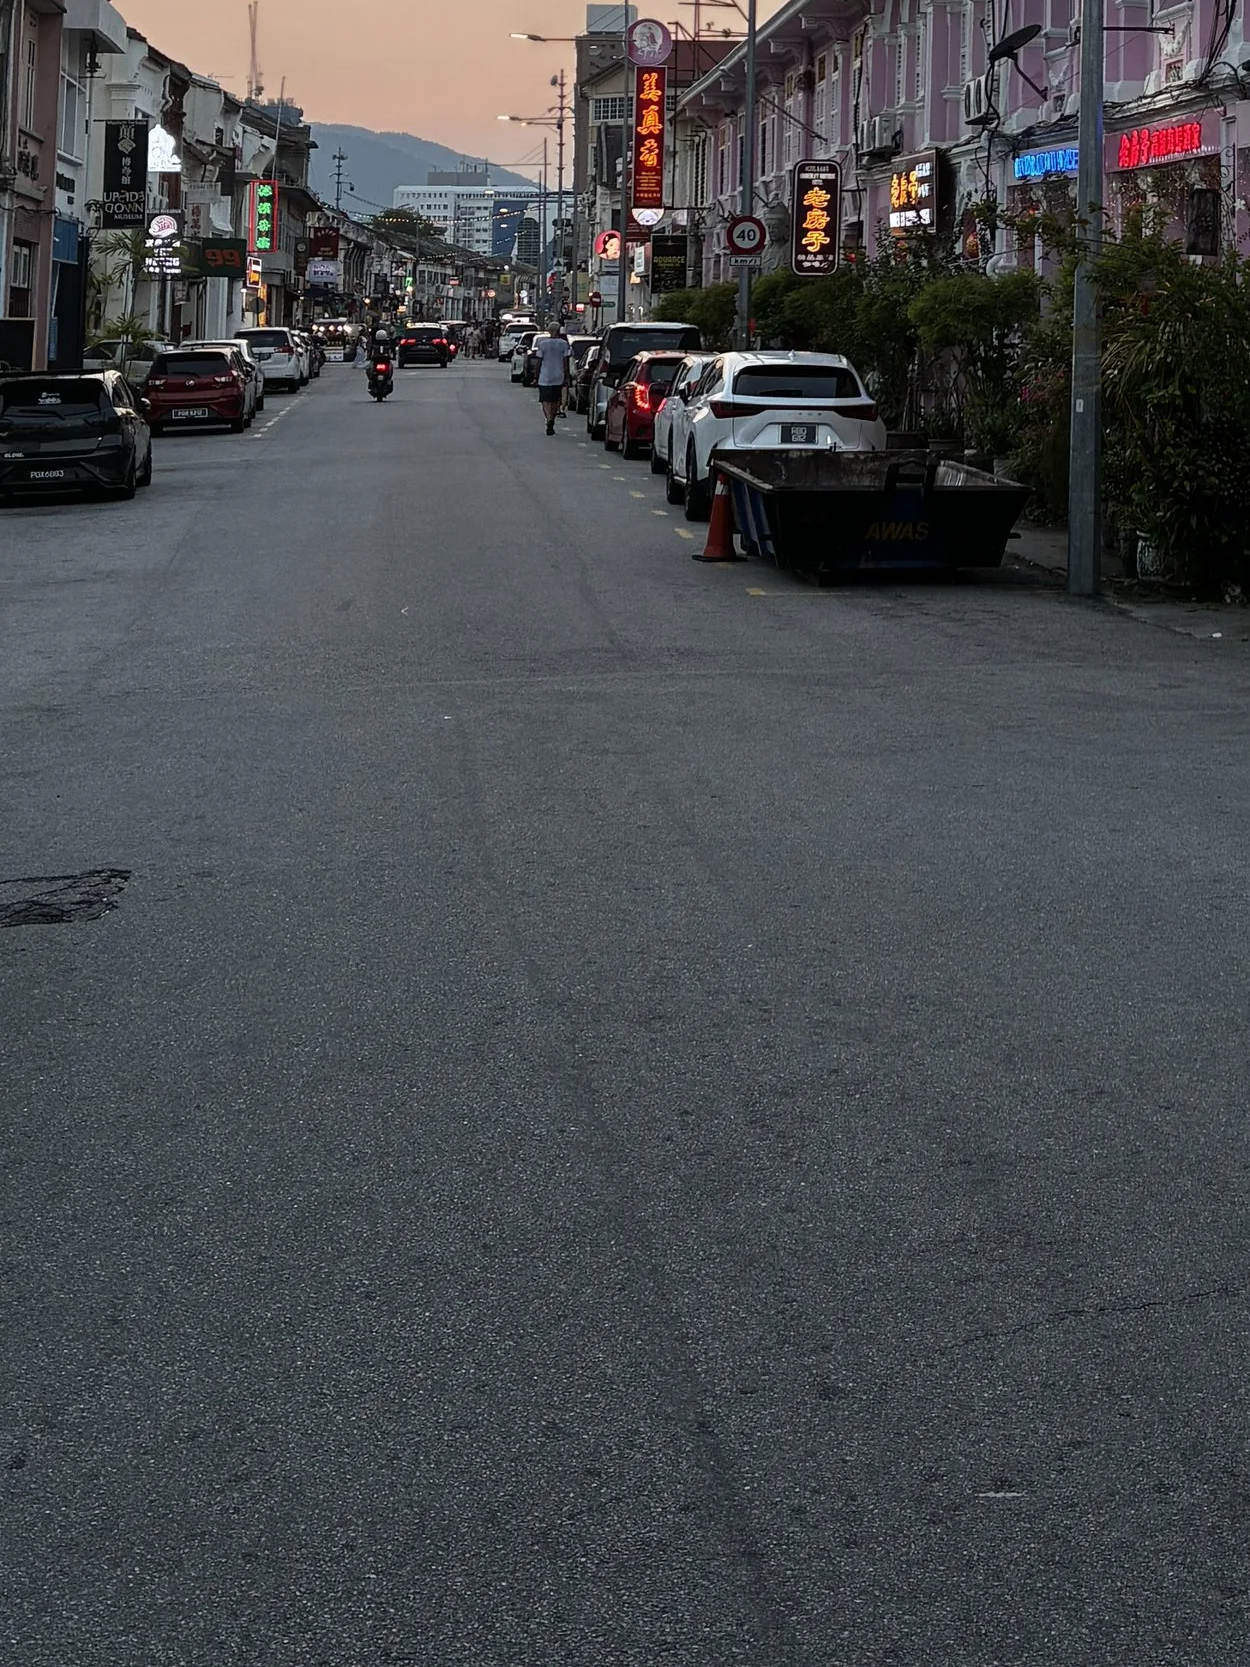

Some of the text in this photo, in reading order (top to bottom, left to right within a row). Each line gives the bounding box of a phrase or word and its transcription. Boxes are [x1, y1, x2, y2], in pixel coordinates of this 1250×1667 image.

[637, 72, 663, 167] 美真香
[736, 228, 757, 242] 40
[801, 186, 831, 253] 老房子
[862, 520, 929, 541] AWAS
